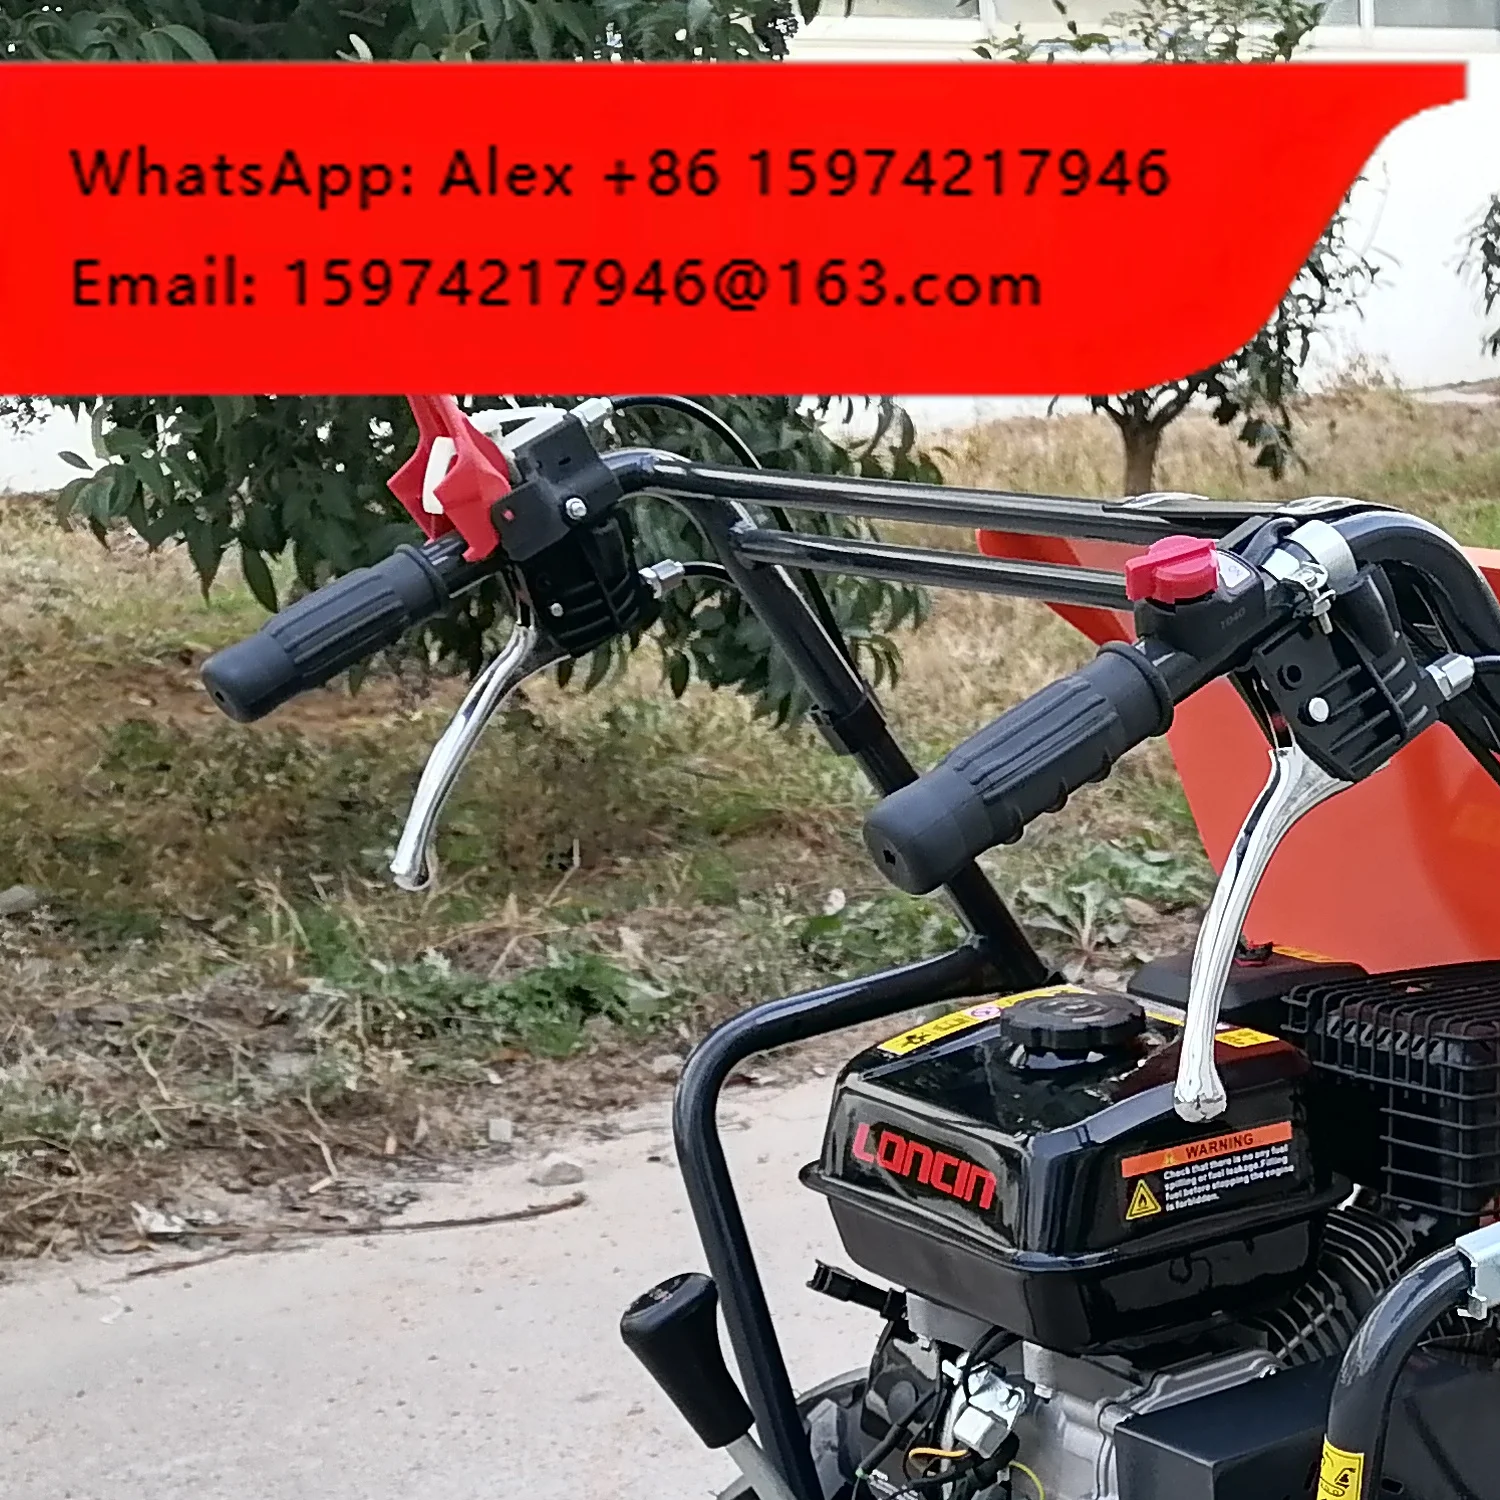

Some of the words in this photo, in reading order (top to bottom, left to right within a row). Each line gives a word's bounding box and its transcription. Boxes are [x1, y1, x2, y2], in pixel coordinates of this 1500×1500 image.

[1163, 1166, 1191, 1180] Check
[1191, 1162, 1209, 1174] that
[1209, 1157, 1232, 1169] there
[1232, 1155, 1241, 1164] is
[1254, 1149, 1270, 1159] any
[1271, 1143, 1289, 1155] fuel
[1185, 1132, 1254, 1159] WARNING
[1165, 1190, 1183, 1201] fuel
[1183, 1184, 1211, 1197] before
[1212, 1174, 1250, 1190] stopping
[1250, 1171, 1264, 1181] the
[1264, 1164, 1295, 1177] engine
[1197, 1173, 1208, 1182] or
[1208, 1168, 1225, 1180] fuel
